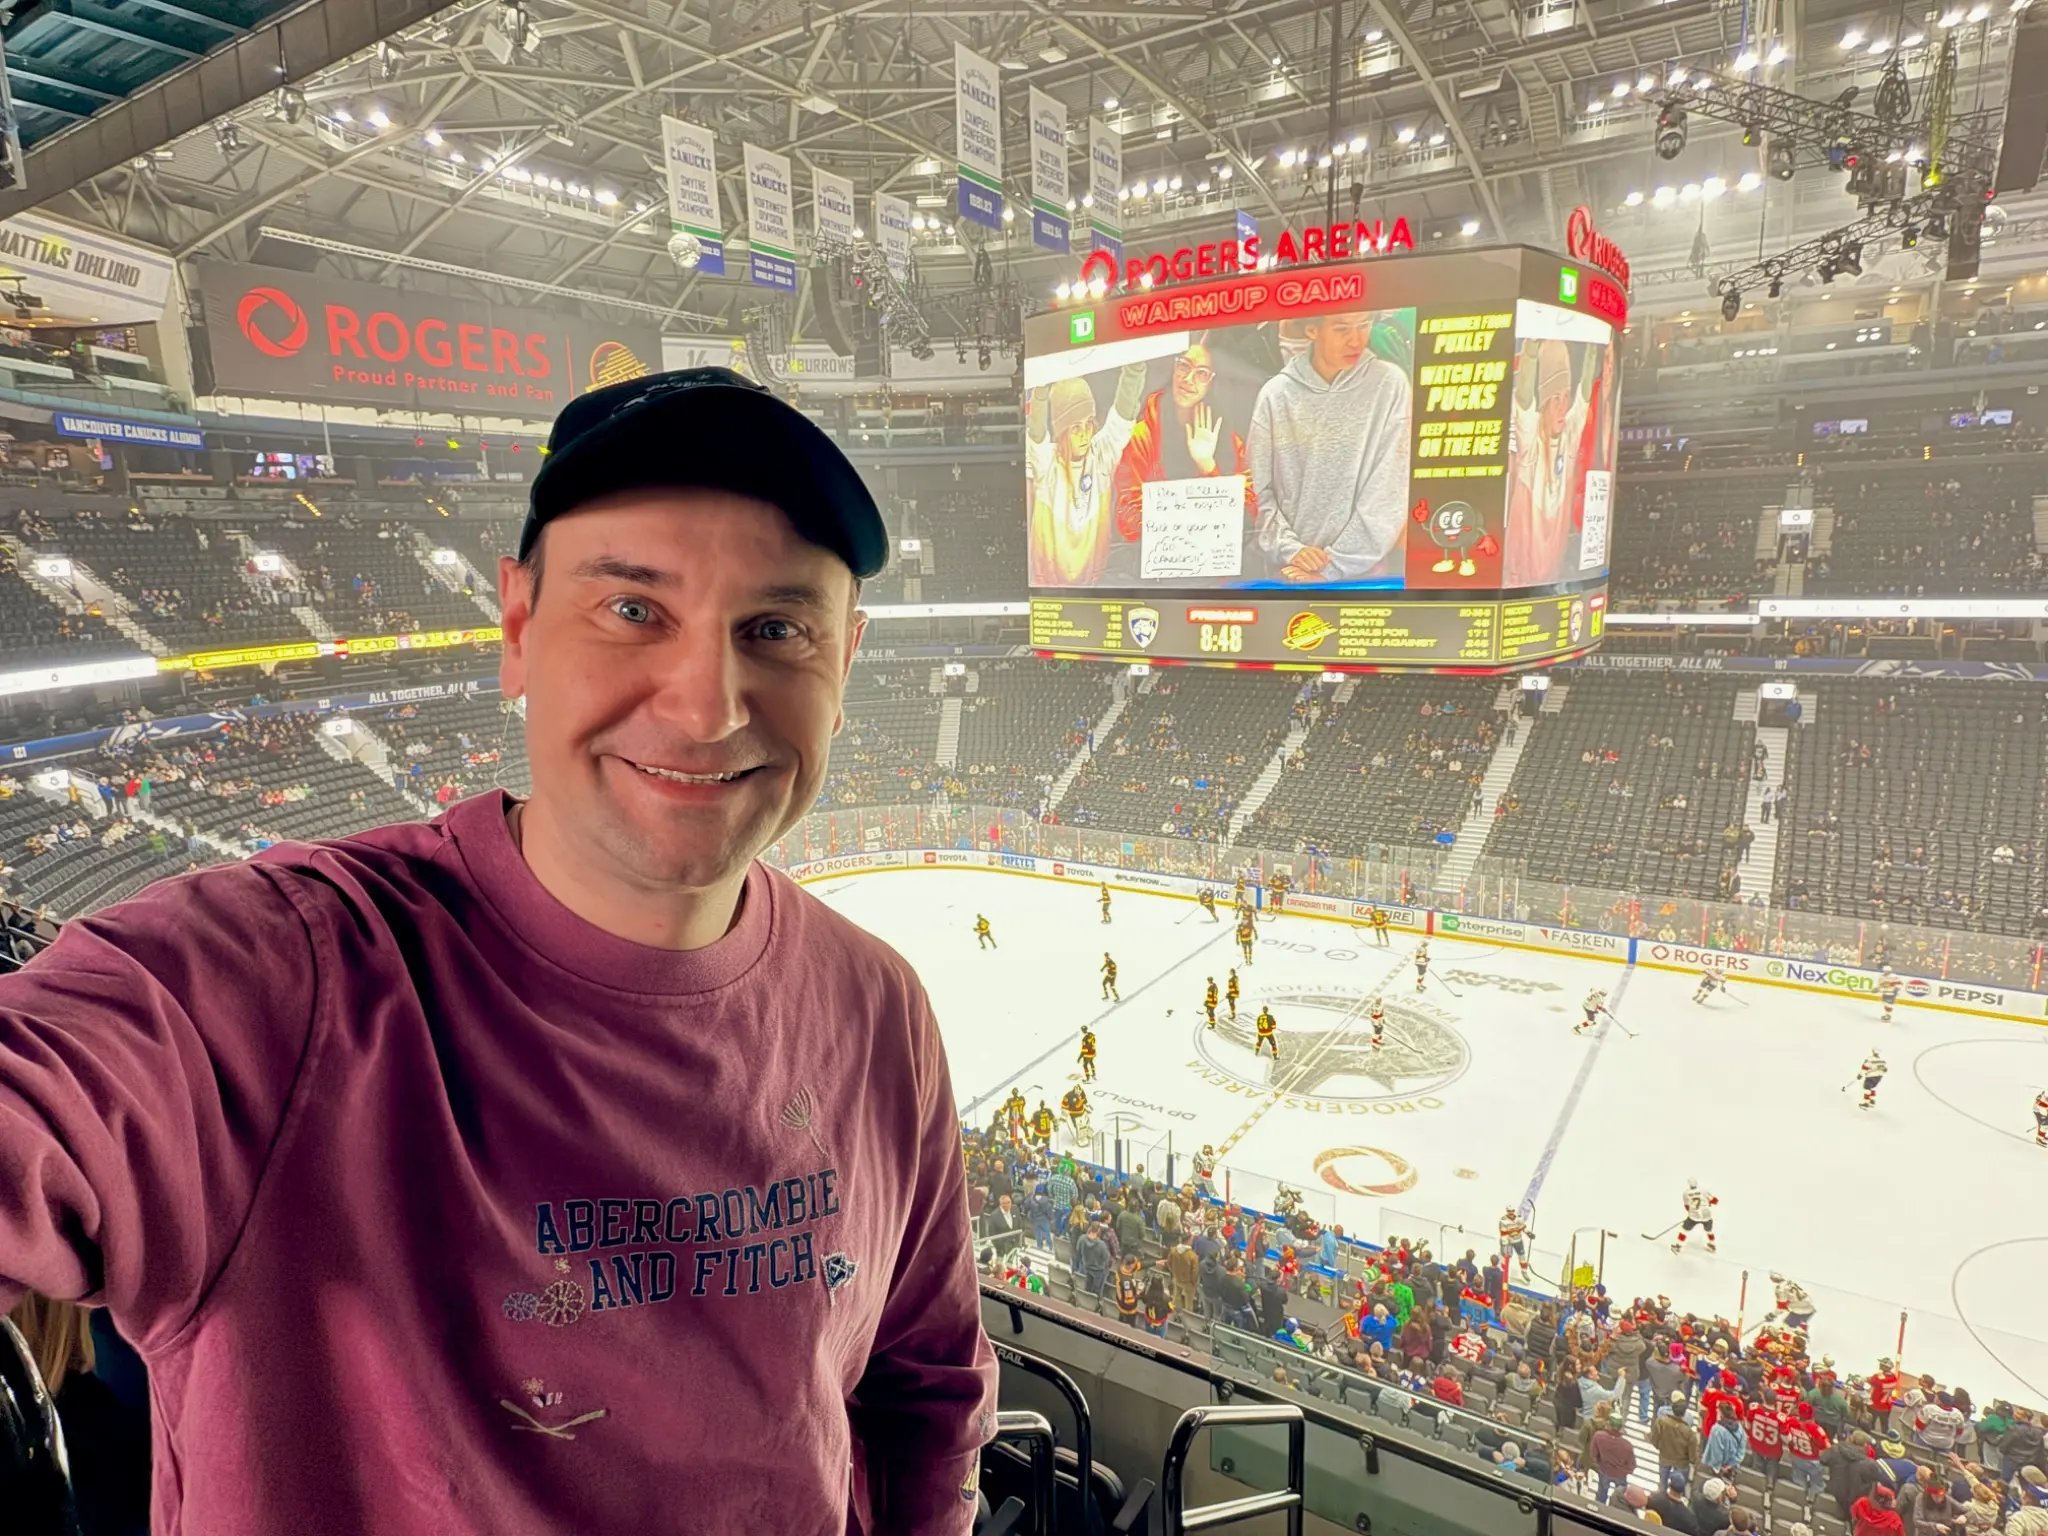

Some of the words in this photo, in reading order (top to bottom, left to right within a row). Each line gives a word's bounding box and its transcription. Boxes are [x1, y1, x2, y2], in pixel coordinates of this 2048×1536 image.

[961, 80, 996, 111] CANUCKS
[1035, 120, 1064, 147] CANUCKS
[670, 147, 711, 171] CANUCKS
[1093, 146, 1118, 171] CANUCKS
[751, 172, 787, 195] CANUCKS
[681, 188, 709, 205] DIVISION
[753, 197, 788, 215] NORTHWEST
[819, 194, 851, 216] CANUCKS
[759, 210, 783, 226] DIVISION
[1127, 237, 1262, 289] ROGERS
[1277, 216, 1415, 264] ARENA
[74, 251, 141, 288] OHLUND
[1121, 286, 1268, 328] WARMUP
[1277, 275, 1362, 306] CAM
[1073, 316, 1092, 338] TD
[325, 304, 551, 378] ROGERS
[1433, 331, 1495, 354] PUXLEY
[797, 358, 855, 373] BURROWS
[1420, 364, 1474, 386] WATCH
[1473, 361, 1507, 383] FOR
[333, 365, 396, 387] Proud
[404, 372, 478, 394] Partner
[487, 383, 518, 398] and
[525, 385, 553, 401] Fan
[1426, 384, 1498, 412] PUCKS
[62, 416, 122, 437] VANCOUVER
[124, 424, 168, 441] CANUCKS
[169, 430, 201, 445] ALUMNI
[1419, 423, 1447, 437] KEEP
[1475, 420, 1502, 434] EYES
[1418, 438, 1442, 457] ON
[1443, 436, 1472, 456] THE
[1472, 435, 1501, 455] ICE
[1340, 608, 1392, 617] RECORD
[1340, 618, 1386, 627] POINTS
[1200, 624, 1242, 652] 8:48
[1339, 628, 1382, 637] GOALS
[1383, 628, 1409, 637] FOR
[1467, 629, 1488, 638] 171
[1339, 638, 1385, 647] GOALS
[1385, 638, 1438, 647] AGAINST
[868, 649, 883, 658] ALL
[1339, 648, 1367, 657] HITS
[1584, 656, 1607, 668] ALL
[1609, 657, 1676, 669] TOGETHER.
[1678, 658, 1702, 670] ALL
[1704, 658, 1723, 670] IN.
[368, 692, 389, 704] ALL
[390, 685, 446, 702] TOGETHER.
[466, 681, 479, 692] IN.
[827, 856, 873, 871] ROGERS
[938, 854, 968, 863] TOYOTA
[1066, 867, 1095, 877] TOYOTA
[1286, 898, 1319, 911] CANADIAN
[1320, 901, 1337, 912] TIRE
[1355, 904, 1375, 917] KA
[1448, 916, 1523, 938] enterprise
[1261, 938, 1316, 954] Clio
[1551, 930, 1616, 949] FASKEN
[1674, 949, 1749, 971] ROGERS
[1786, 964, 1874, 991] NexGen
[1938, 986, 2004, 1007] PEPSI
[1185, 1059, 1266, 1099] ARENA
[1093, 1090, 1163, 1114] WORLD
[1167, 1110, 1197, 1120] DP
[536, 1168, 840, 1255] ABERCROMBIE
[588, 1250, 676, 1311] AND
[691, 1231, 817, 1297] FITCH
[997, 1347, 1025, 1367] RAIL
[1752, 1422, 1779, 1445] 63
